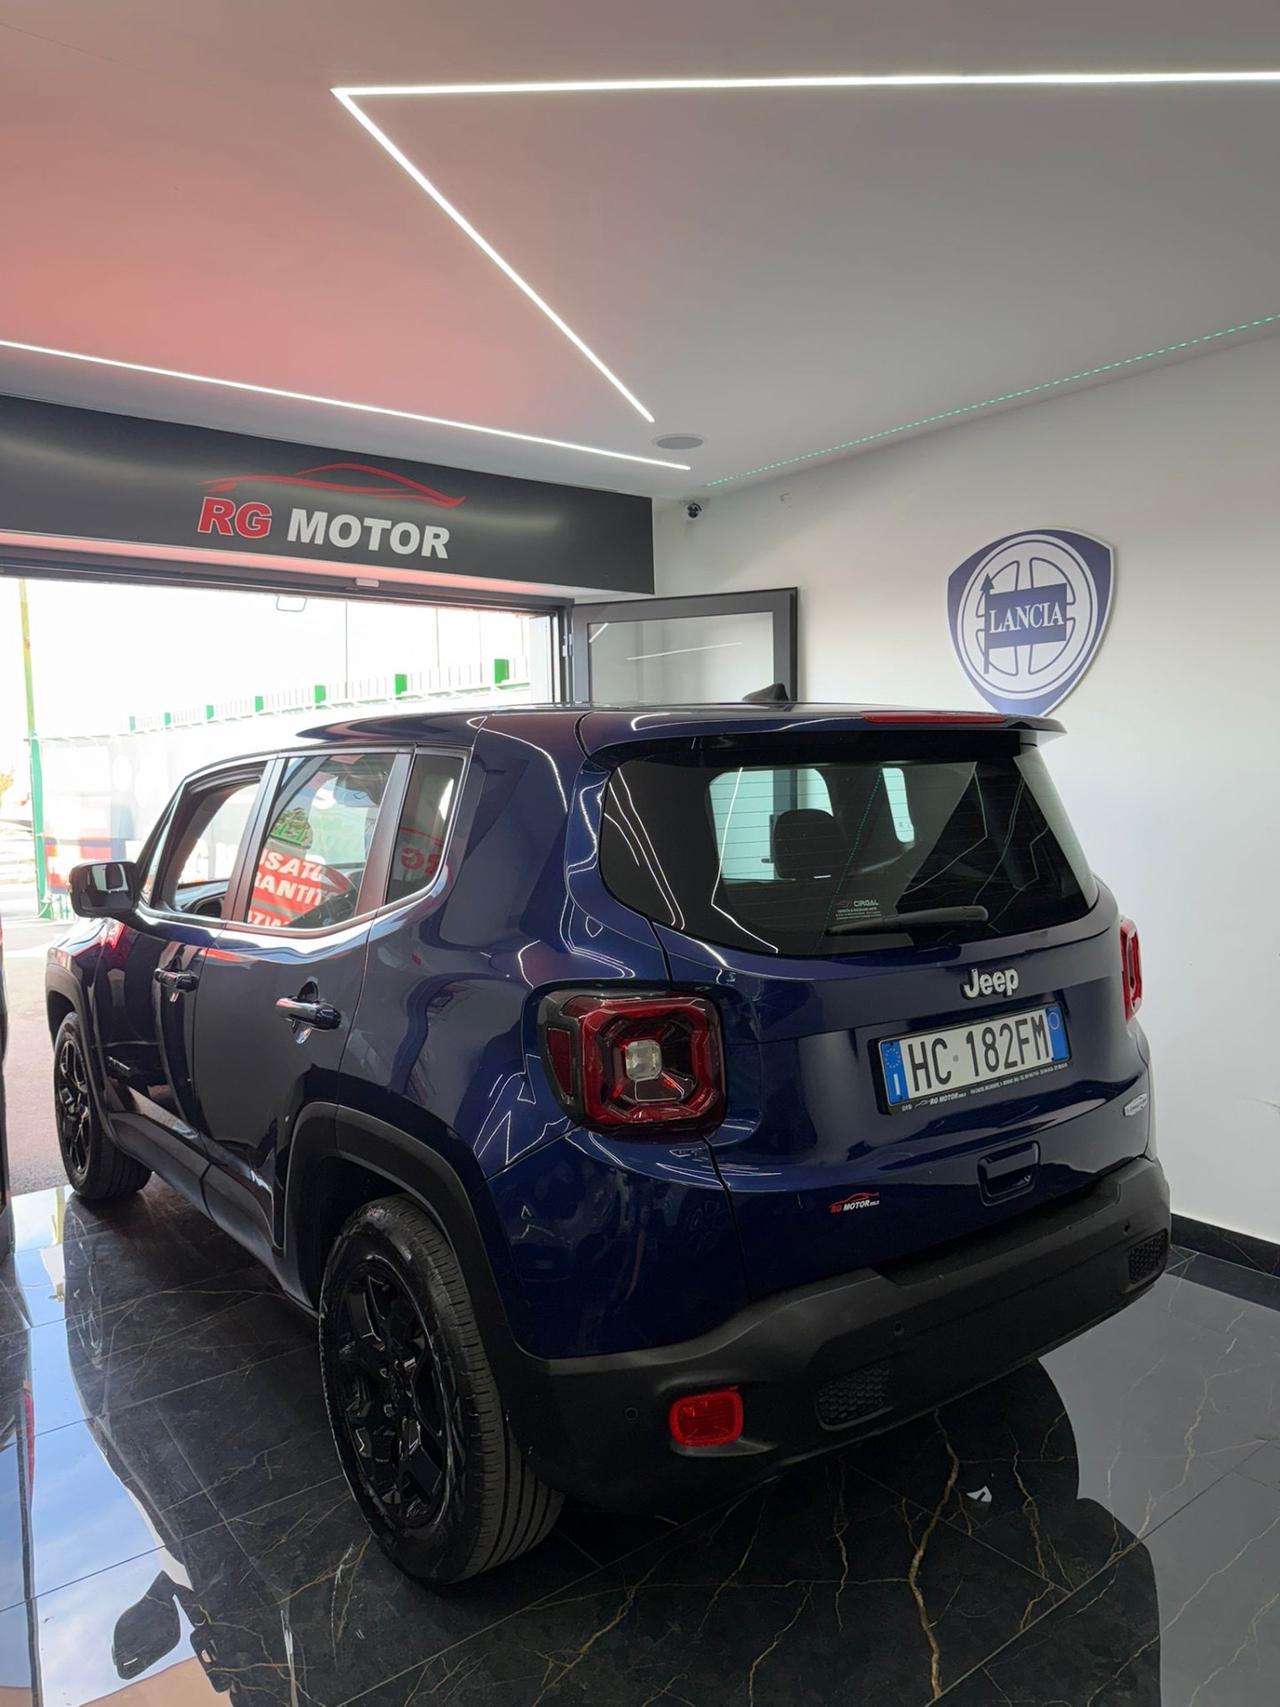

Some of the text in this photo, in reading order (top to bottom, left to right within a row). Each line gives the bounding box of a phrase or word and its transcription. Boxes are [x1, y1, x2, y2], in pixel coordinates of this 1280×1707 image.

[197, 496, 450, 559] RG MOTOR
[989, 601, 1065, 634] LANCIA
[963, 968, 1019, 998] Jeep
[907, 1038, 952, 1092] HC
[965, 1014, 1051, 1077] 182FM
[893, 1073, 901, 1096] I
[843, 1199, 870, 1211] MOTOR
